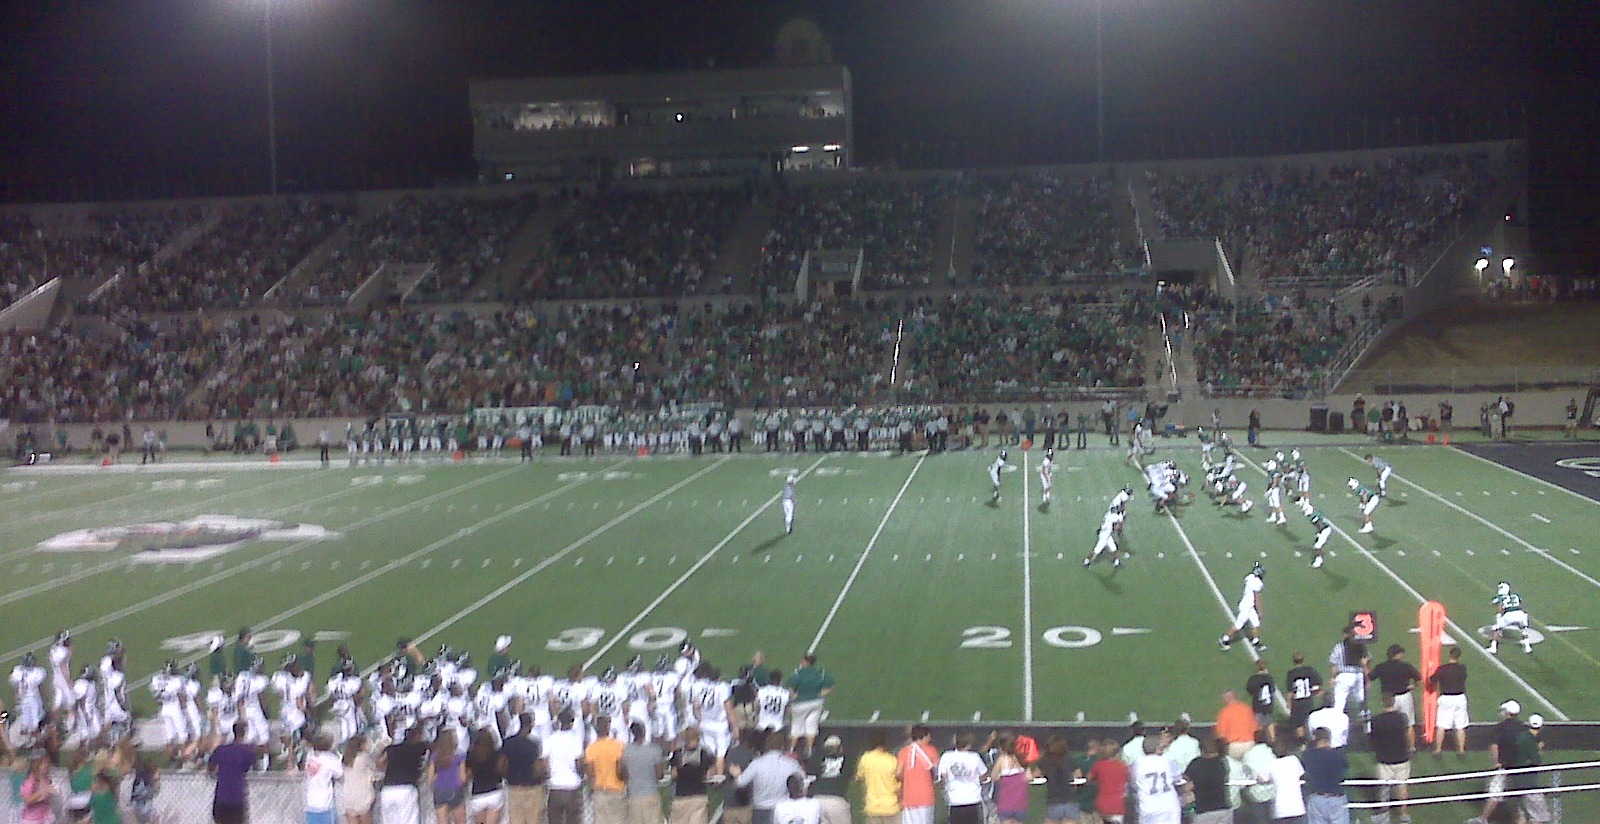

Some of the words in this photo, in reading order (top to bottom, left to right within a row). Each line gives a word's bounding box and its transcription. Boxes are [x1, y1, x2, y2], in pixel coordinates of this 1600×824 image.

[1354, 612, 1374, 636] 3
[960, 625, 1103, 649] 20
[1259, 685, 1272, 705] 4
[1145, 772, 1171, 795] 71
